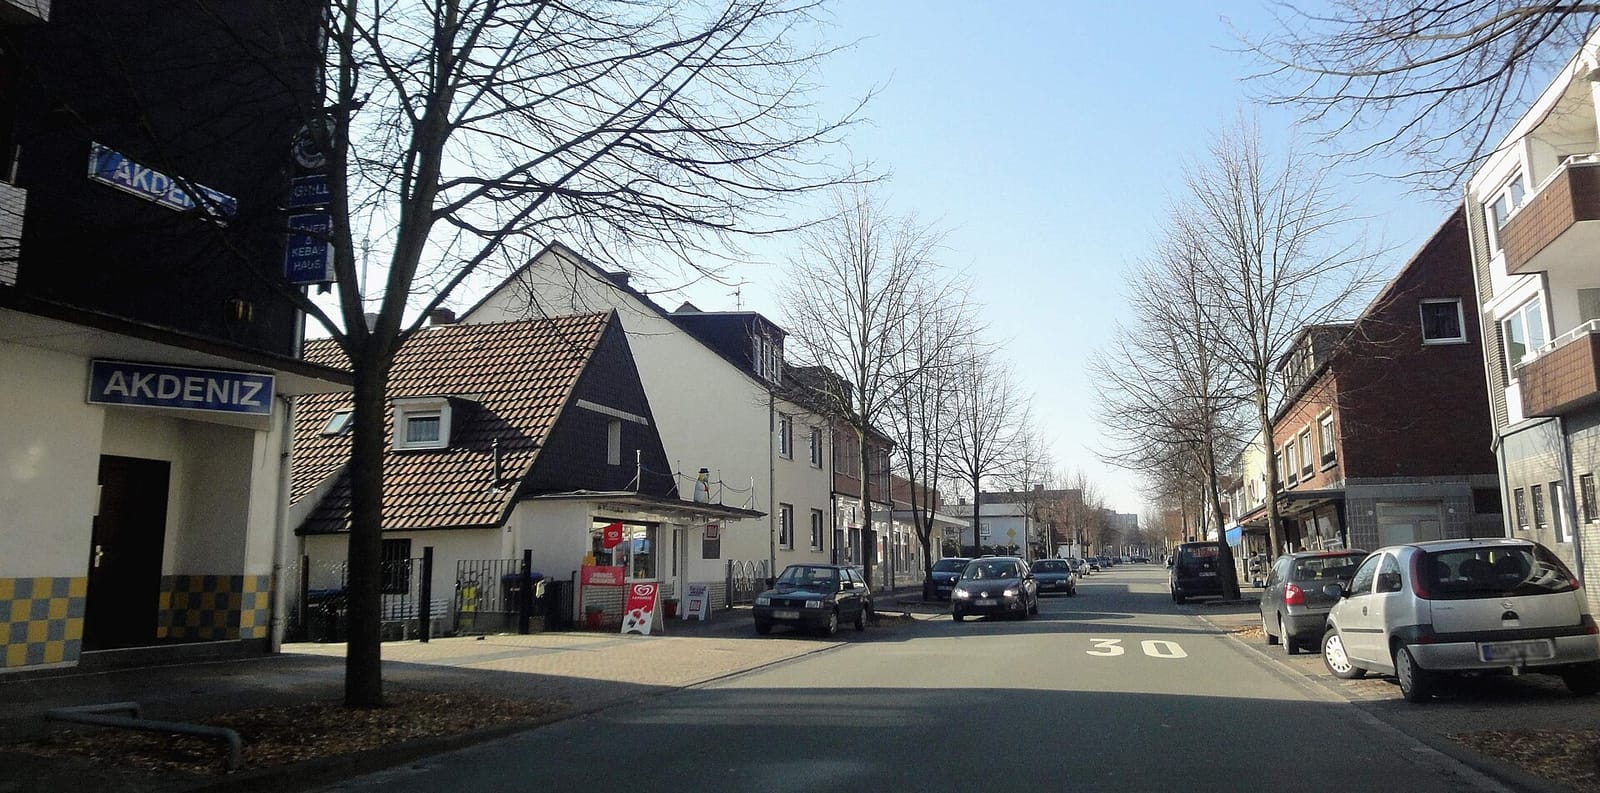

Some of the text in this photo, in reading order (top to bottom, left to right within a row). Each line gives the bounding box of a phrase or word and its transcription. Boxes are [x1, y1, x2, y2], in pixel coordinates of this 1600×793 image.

[112, 158, 224, 216] AKDE
[291, 223, 326, 236] NER
[103, 370, 263, 407] AKDENIZ
[1085, 638, 1188, 659] 30
